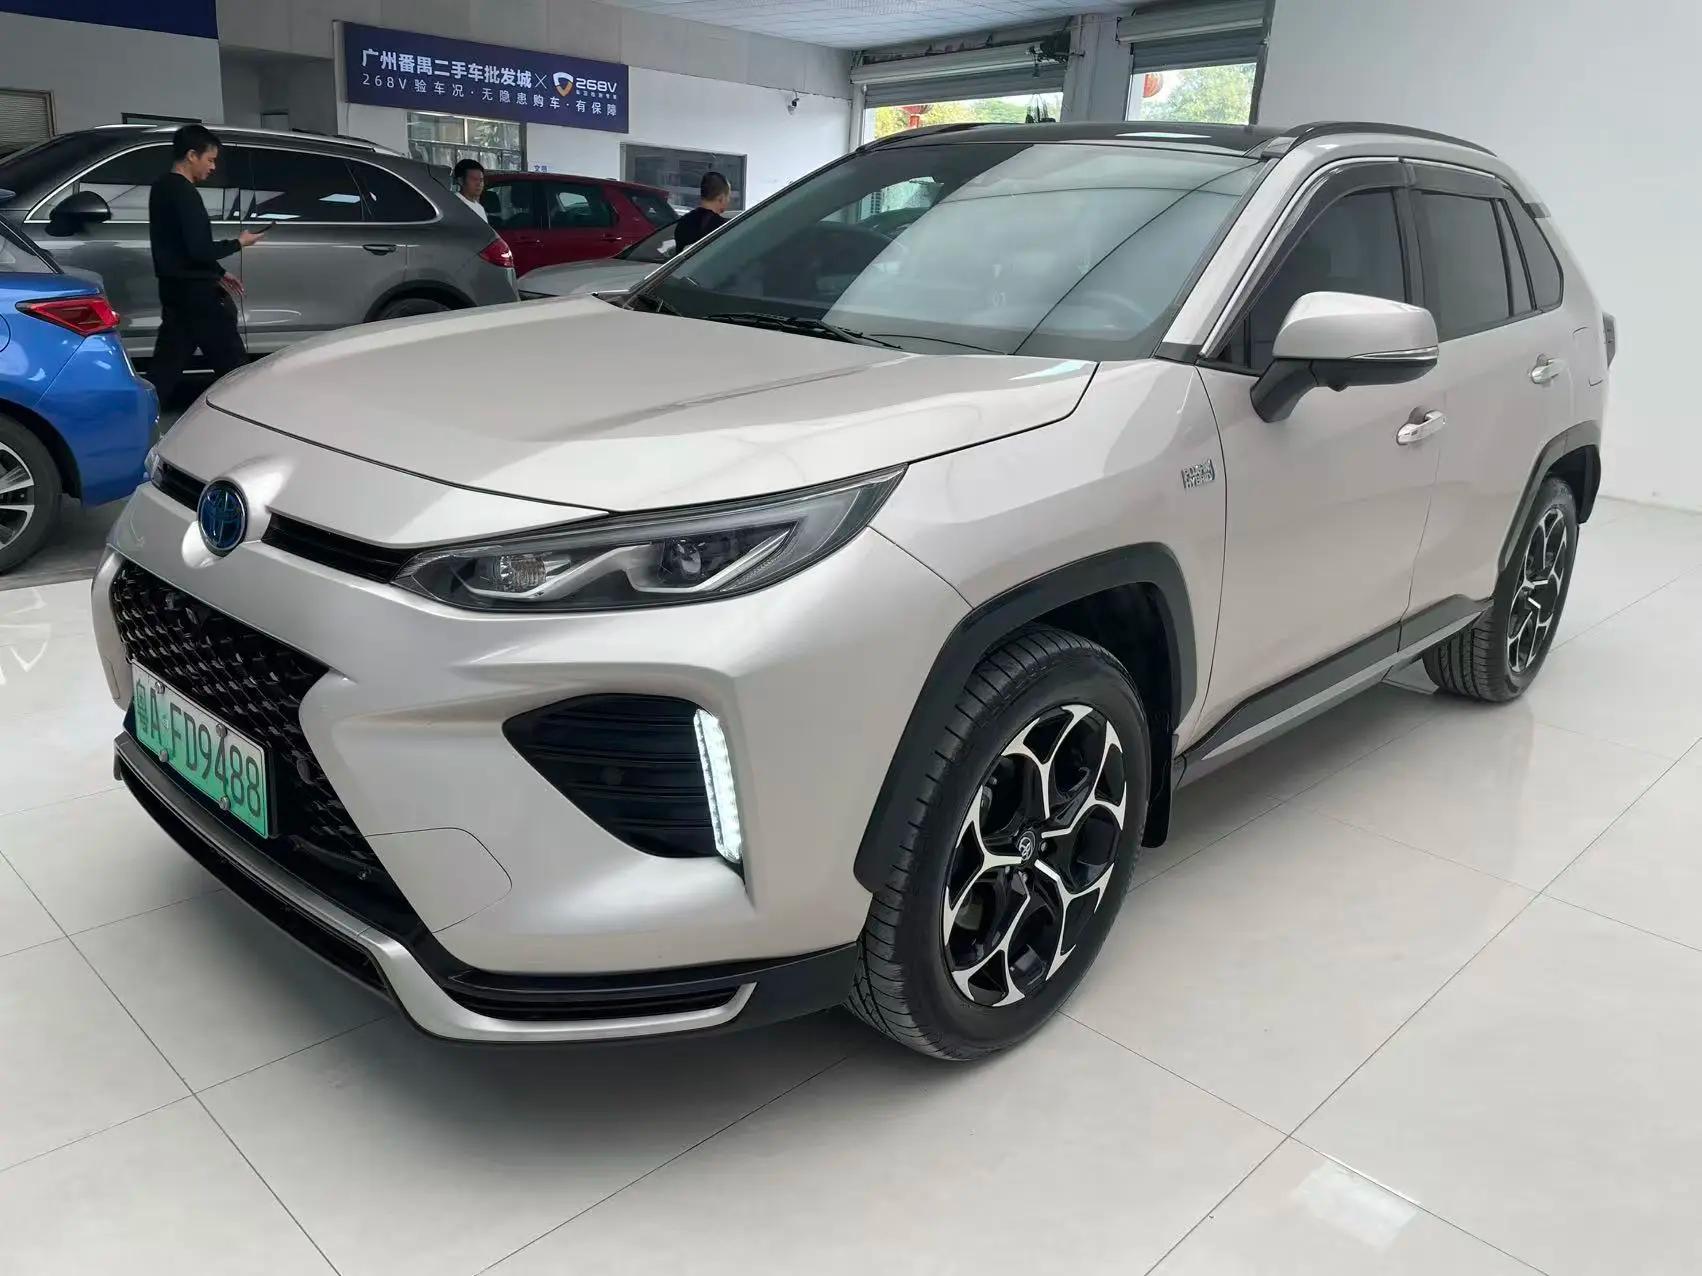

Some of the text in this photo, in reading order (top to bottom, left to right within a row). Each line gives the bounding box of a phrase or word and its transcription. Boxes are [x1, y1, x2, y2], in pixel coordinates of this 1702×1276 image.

[362, 48, 532, 89] 广州番禺二手车批发城
[576, 77, 617, 92] 268V
